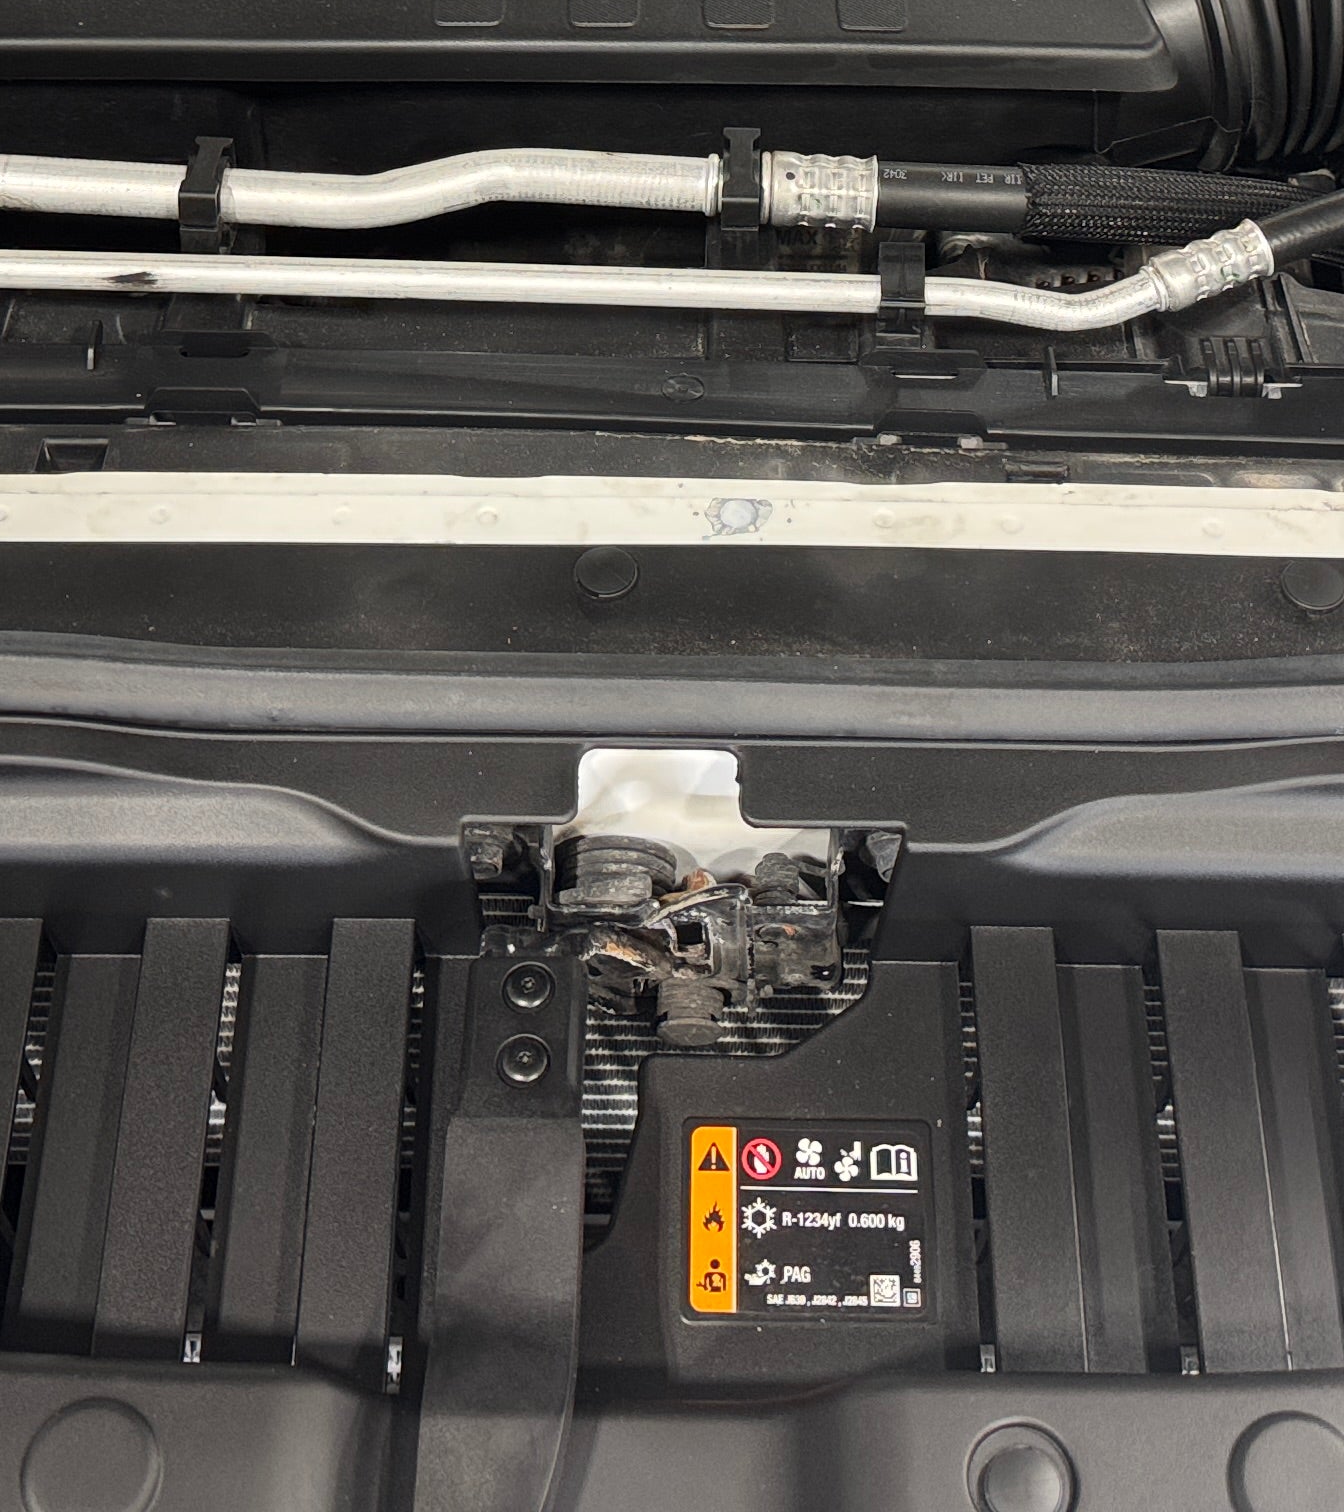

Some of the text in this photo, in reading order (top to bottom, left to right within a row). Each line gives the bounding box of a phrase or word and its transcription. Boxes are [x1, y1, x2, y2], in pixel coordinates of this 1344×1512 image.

[883, 168, 907, 180] 3042
[794, 1166, 825, 1180] AUTO
[782, 1212, 905, 1232] R-1234yf 0.600 kg
[783, 1266, 811, 1283] PAG
[766, 1293, 784, 1305] SAE
